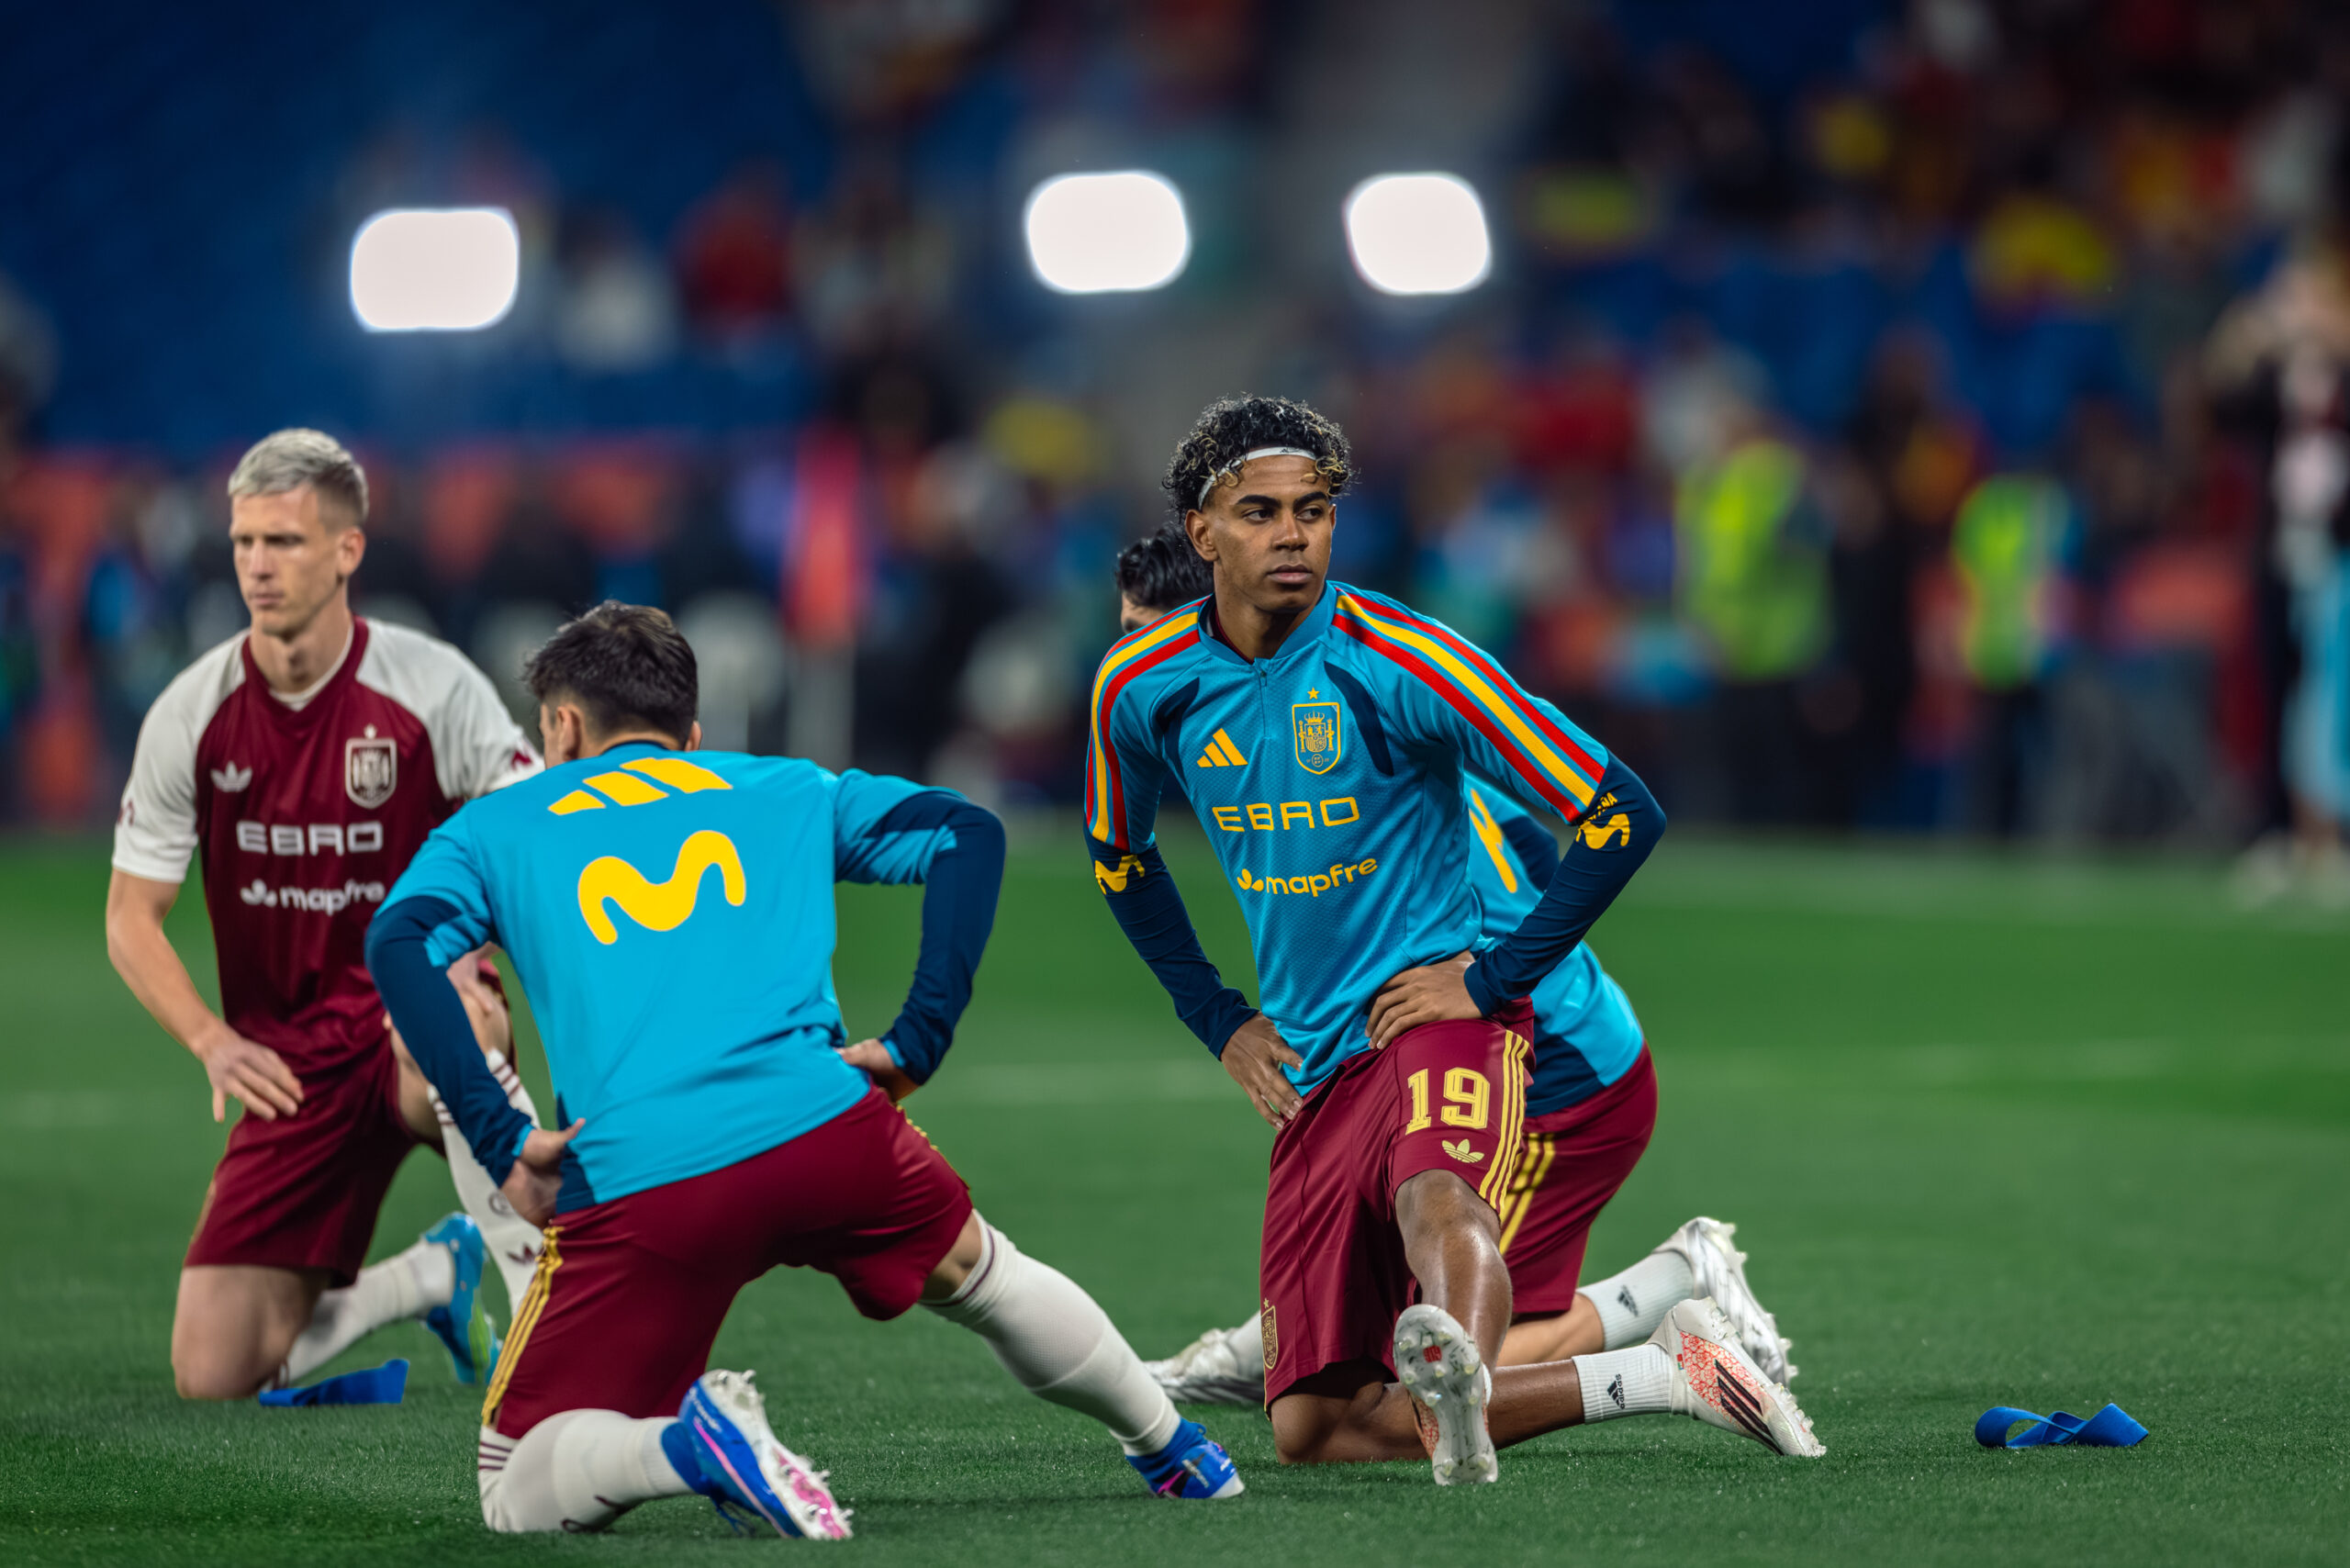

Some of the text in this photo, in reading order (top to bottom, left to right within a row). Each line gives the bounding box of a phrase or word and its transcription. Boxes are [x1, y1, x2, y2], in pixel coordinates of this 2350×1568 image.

[1212, 796, 1360, 833] EBRO
[236, 820, 384, 857] EBRO
[1266, 857, 1378, 898] mapfre
[279, 878, 386, 916] mapfre
[1404, 1067, 1491, 1136] 19
[1616, 1373, 1625, 1409] adidas
